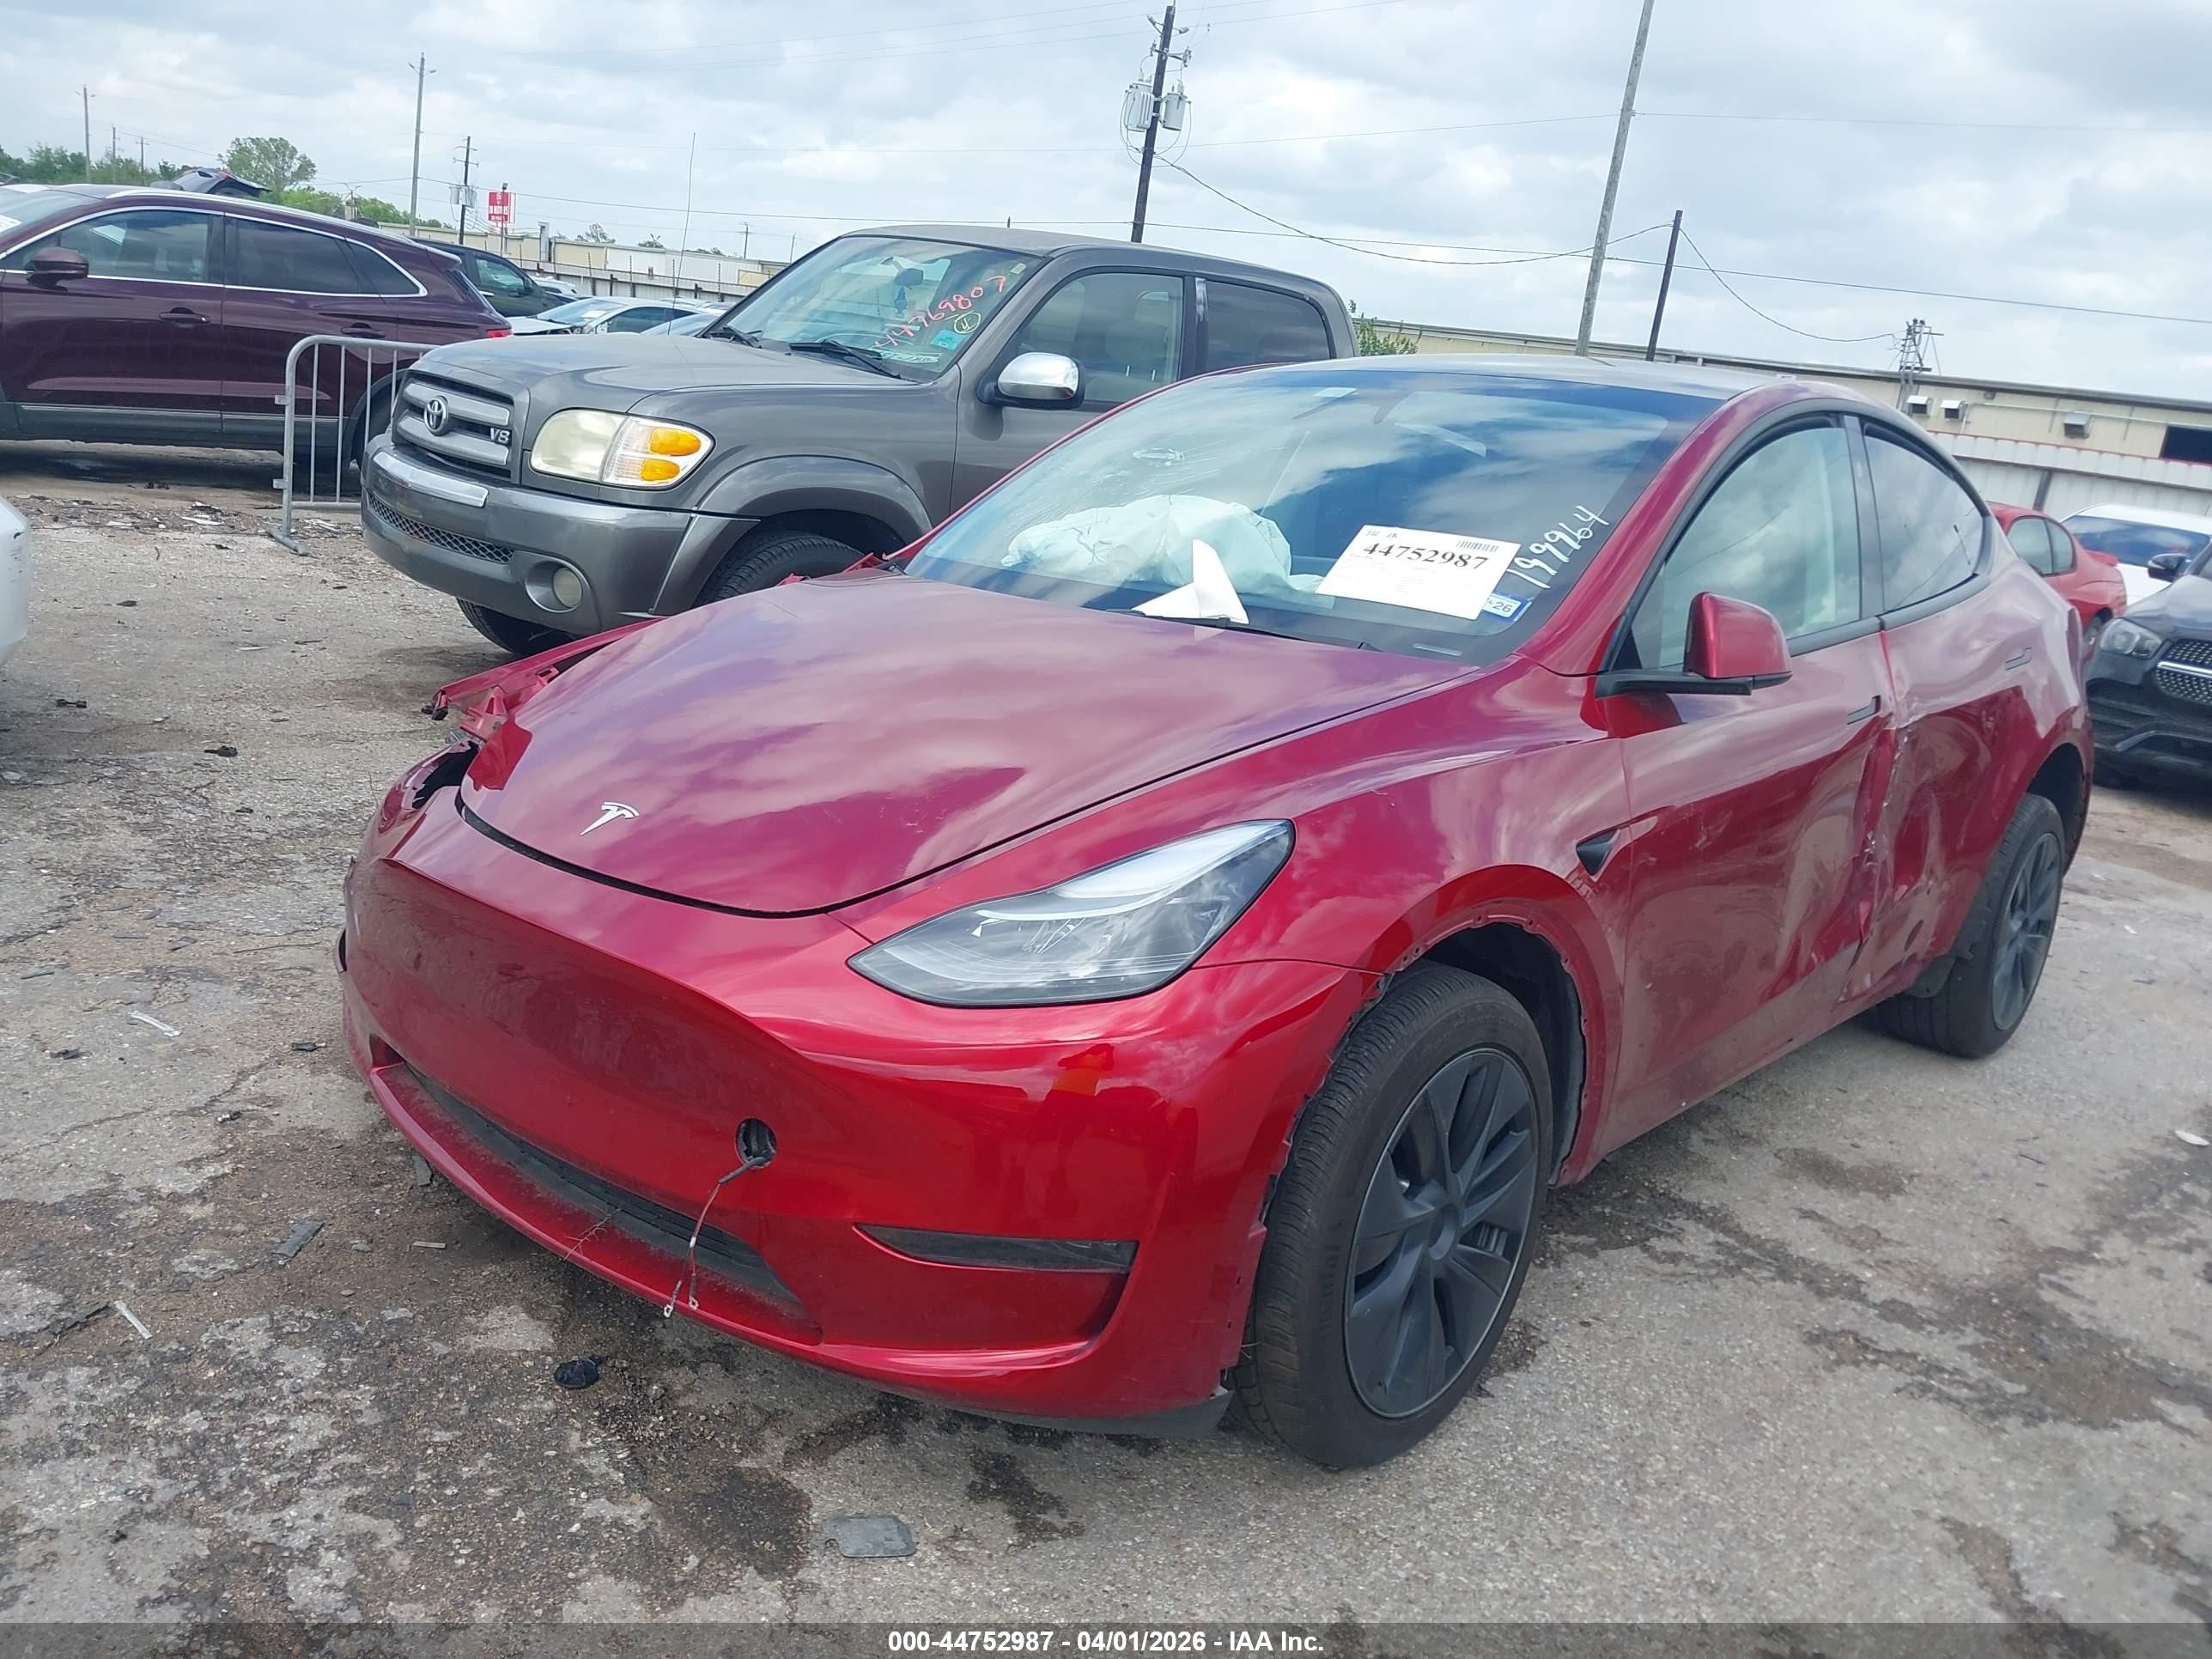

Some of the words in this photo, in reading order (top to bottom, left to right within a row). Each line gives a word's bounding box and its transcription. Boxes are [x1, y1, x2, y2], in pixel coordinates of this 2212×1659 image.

[872, 276, 1006, 347] 44769807
[490, 428, 510, 444] V8
[1363, 543, 1490, 569] 44752987
